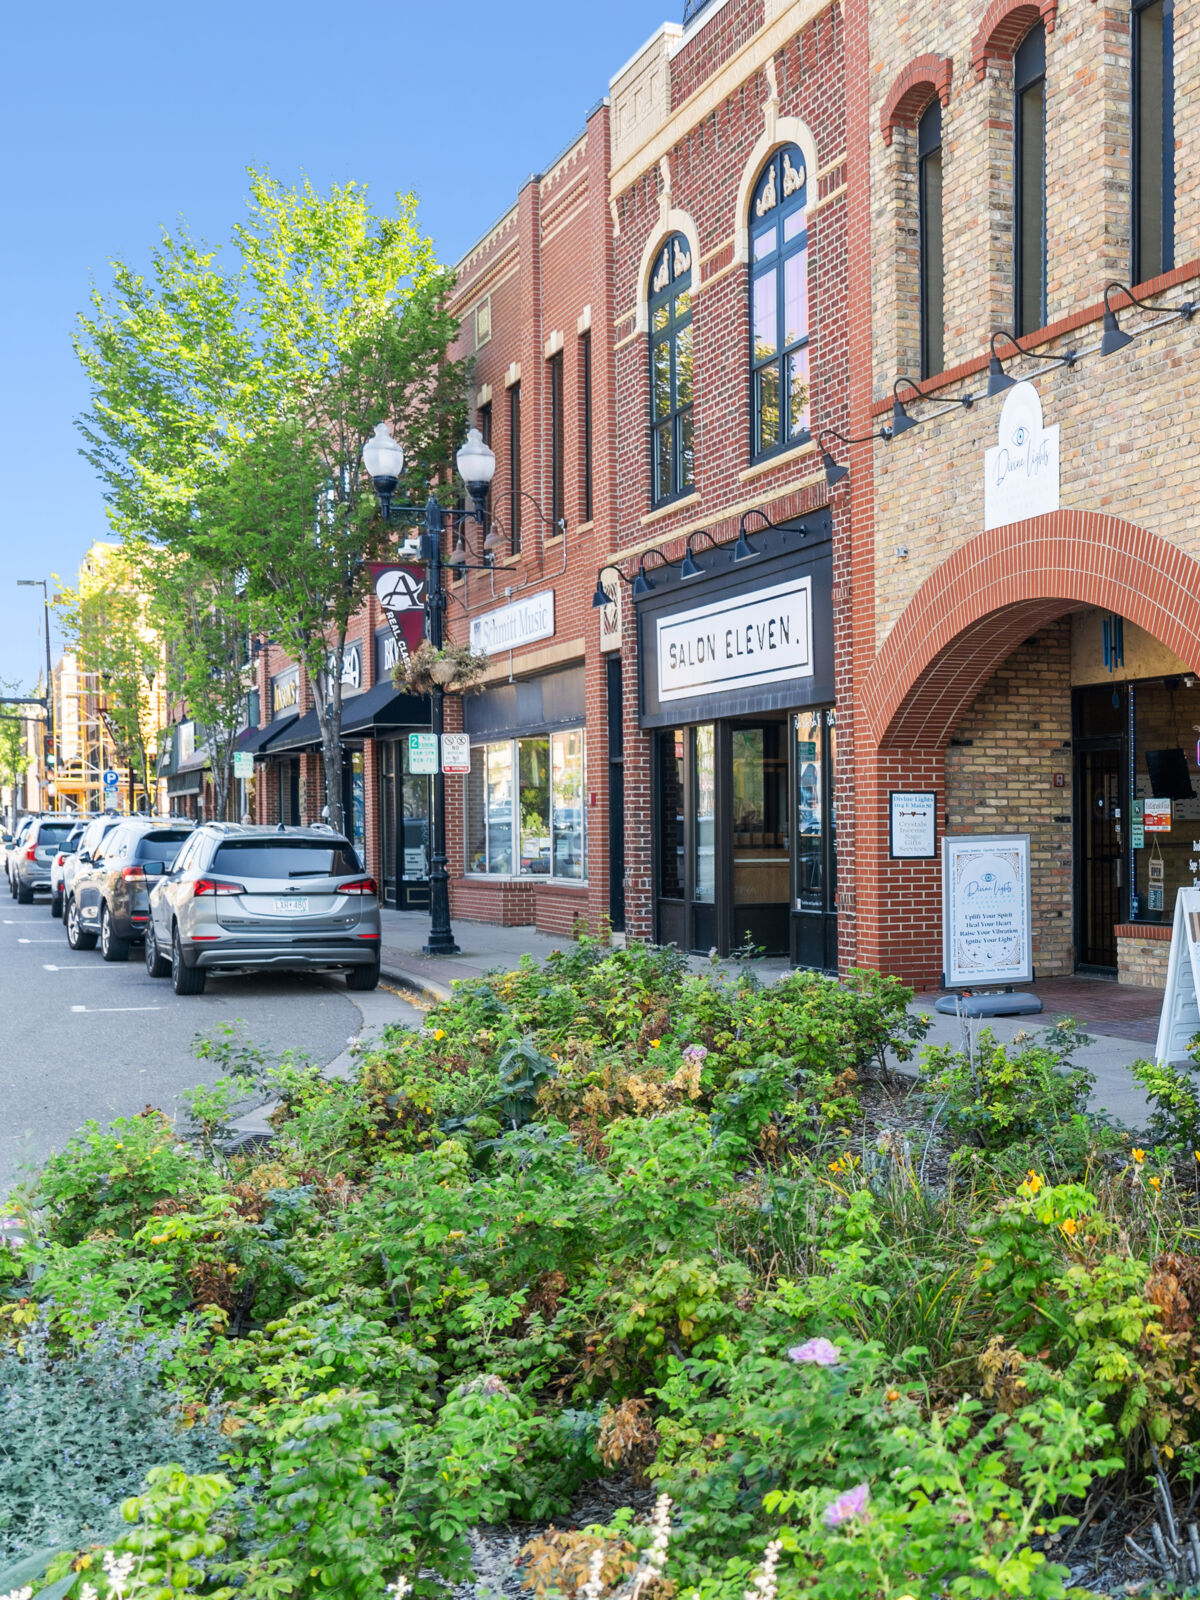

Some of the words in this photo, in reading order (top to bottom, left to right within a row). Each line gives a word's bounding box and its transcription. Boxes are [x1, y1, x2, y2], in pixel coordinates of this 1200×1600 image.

[993, 448, 1025, 487] Divine
[382, 574, 424, 608] A
[483, 614, 517, 648] Schmitt
[519, 603, 547, 637] Music
[669, 633, 716, 670] SALON
[725, 615, 800, 659] ELEVEN.
[411, 736, 418, 748] 2
[107, 772, 116, 784] P
[998, 935, 1012, 943] Light
